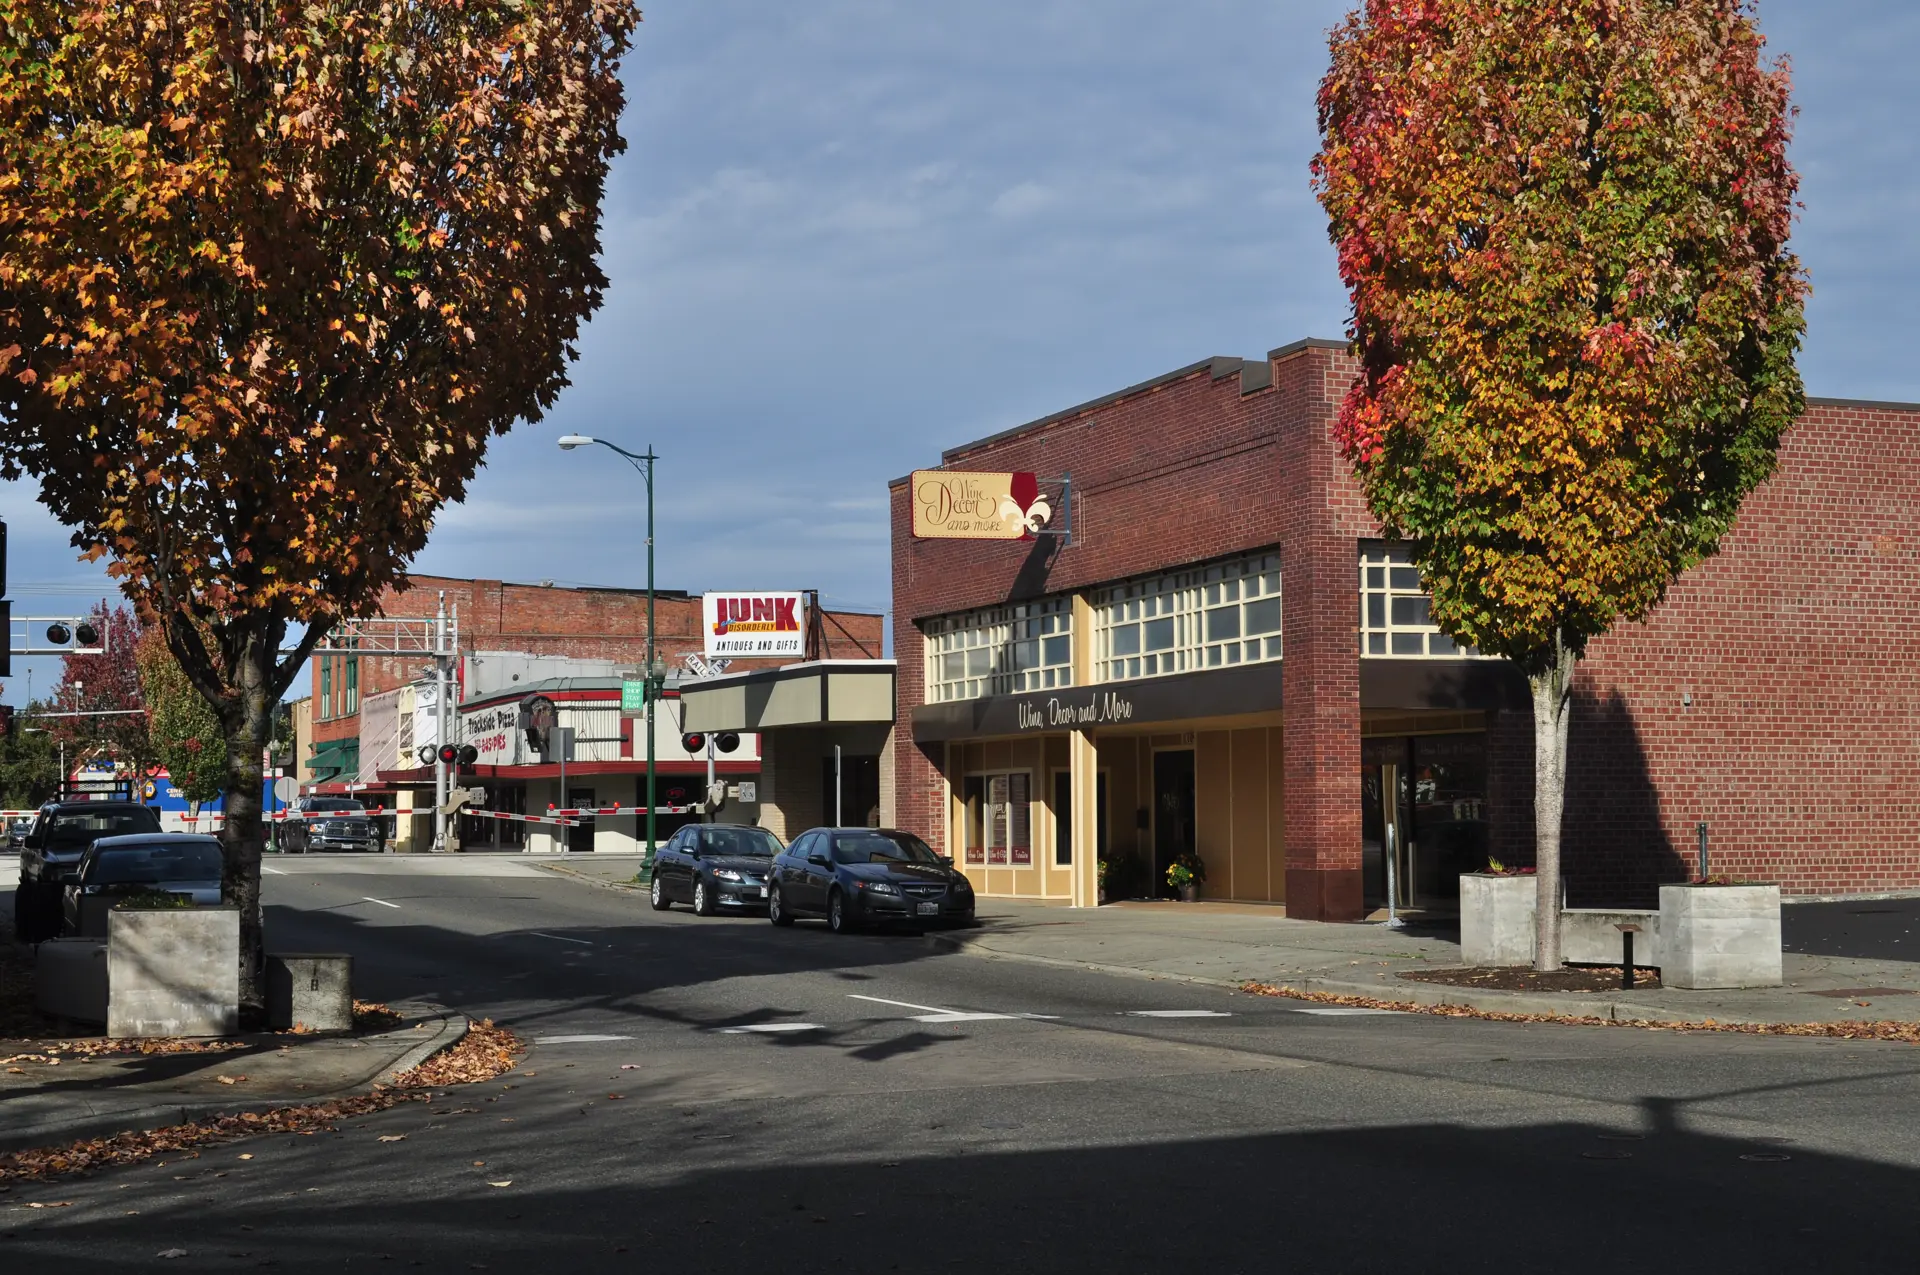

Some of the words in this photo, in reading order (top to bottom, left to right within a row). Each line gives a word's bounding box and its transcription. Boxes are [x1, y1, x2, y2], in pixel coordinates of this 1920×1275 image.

[949, 477, 989, 500] Wine
[714, 597, 798, 636] JUNK
[728, 623, 776, 632] DISORDERLY
[715, 641, 754, 651] ANTIQUES
[757, 641, 773, 651] AND
[776, 640, 798, 650] GIFTS
[688, 655, 706, 676] RAIL
[1018, 700, 1044, 729] Wine,
[1078, 692, 1098, 723] and
[1098, 692, 1133, 722] More
[468, 713, 496, 735] Trackside
[497, 710, 515, 729] Pizza
